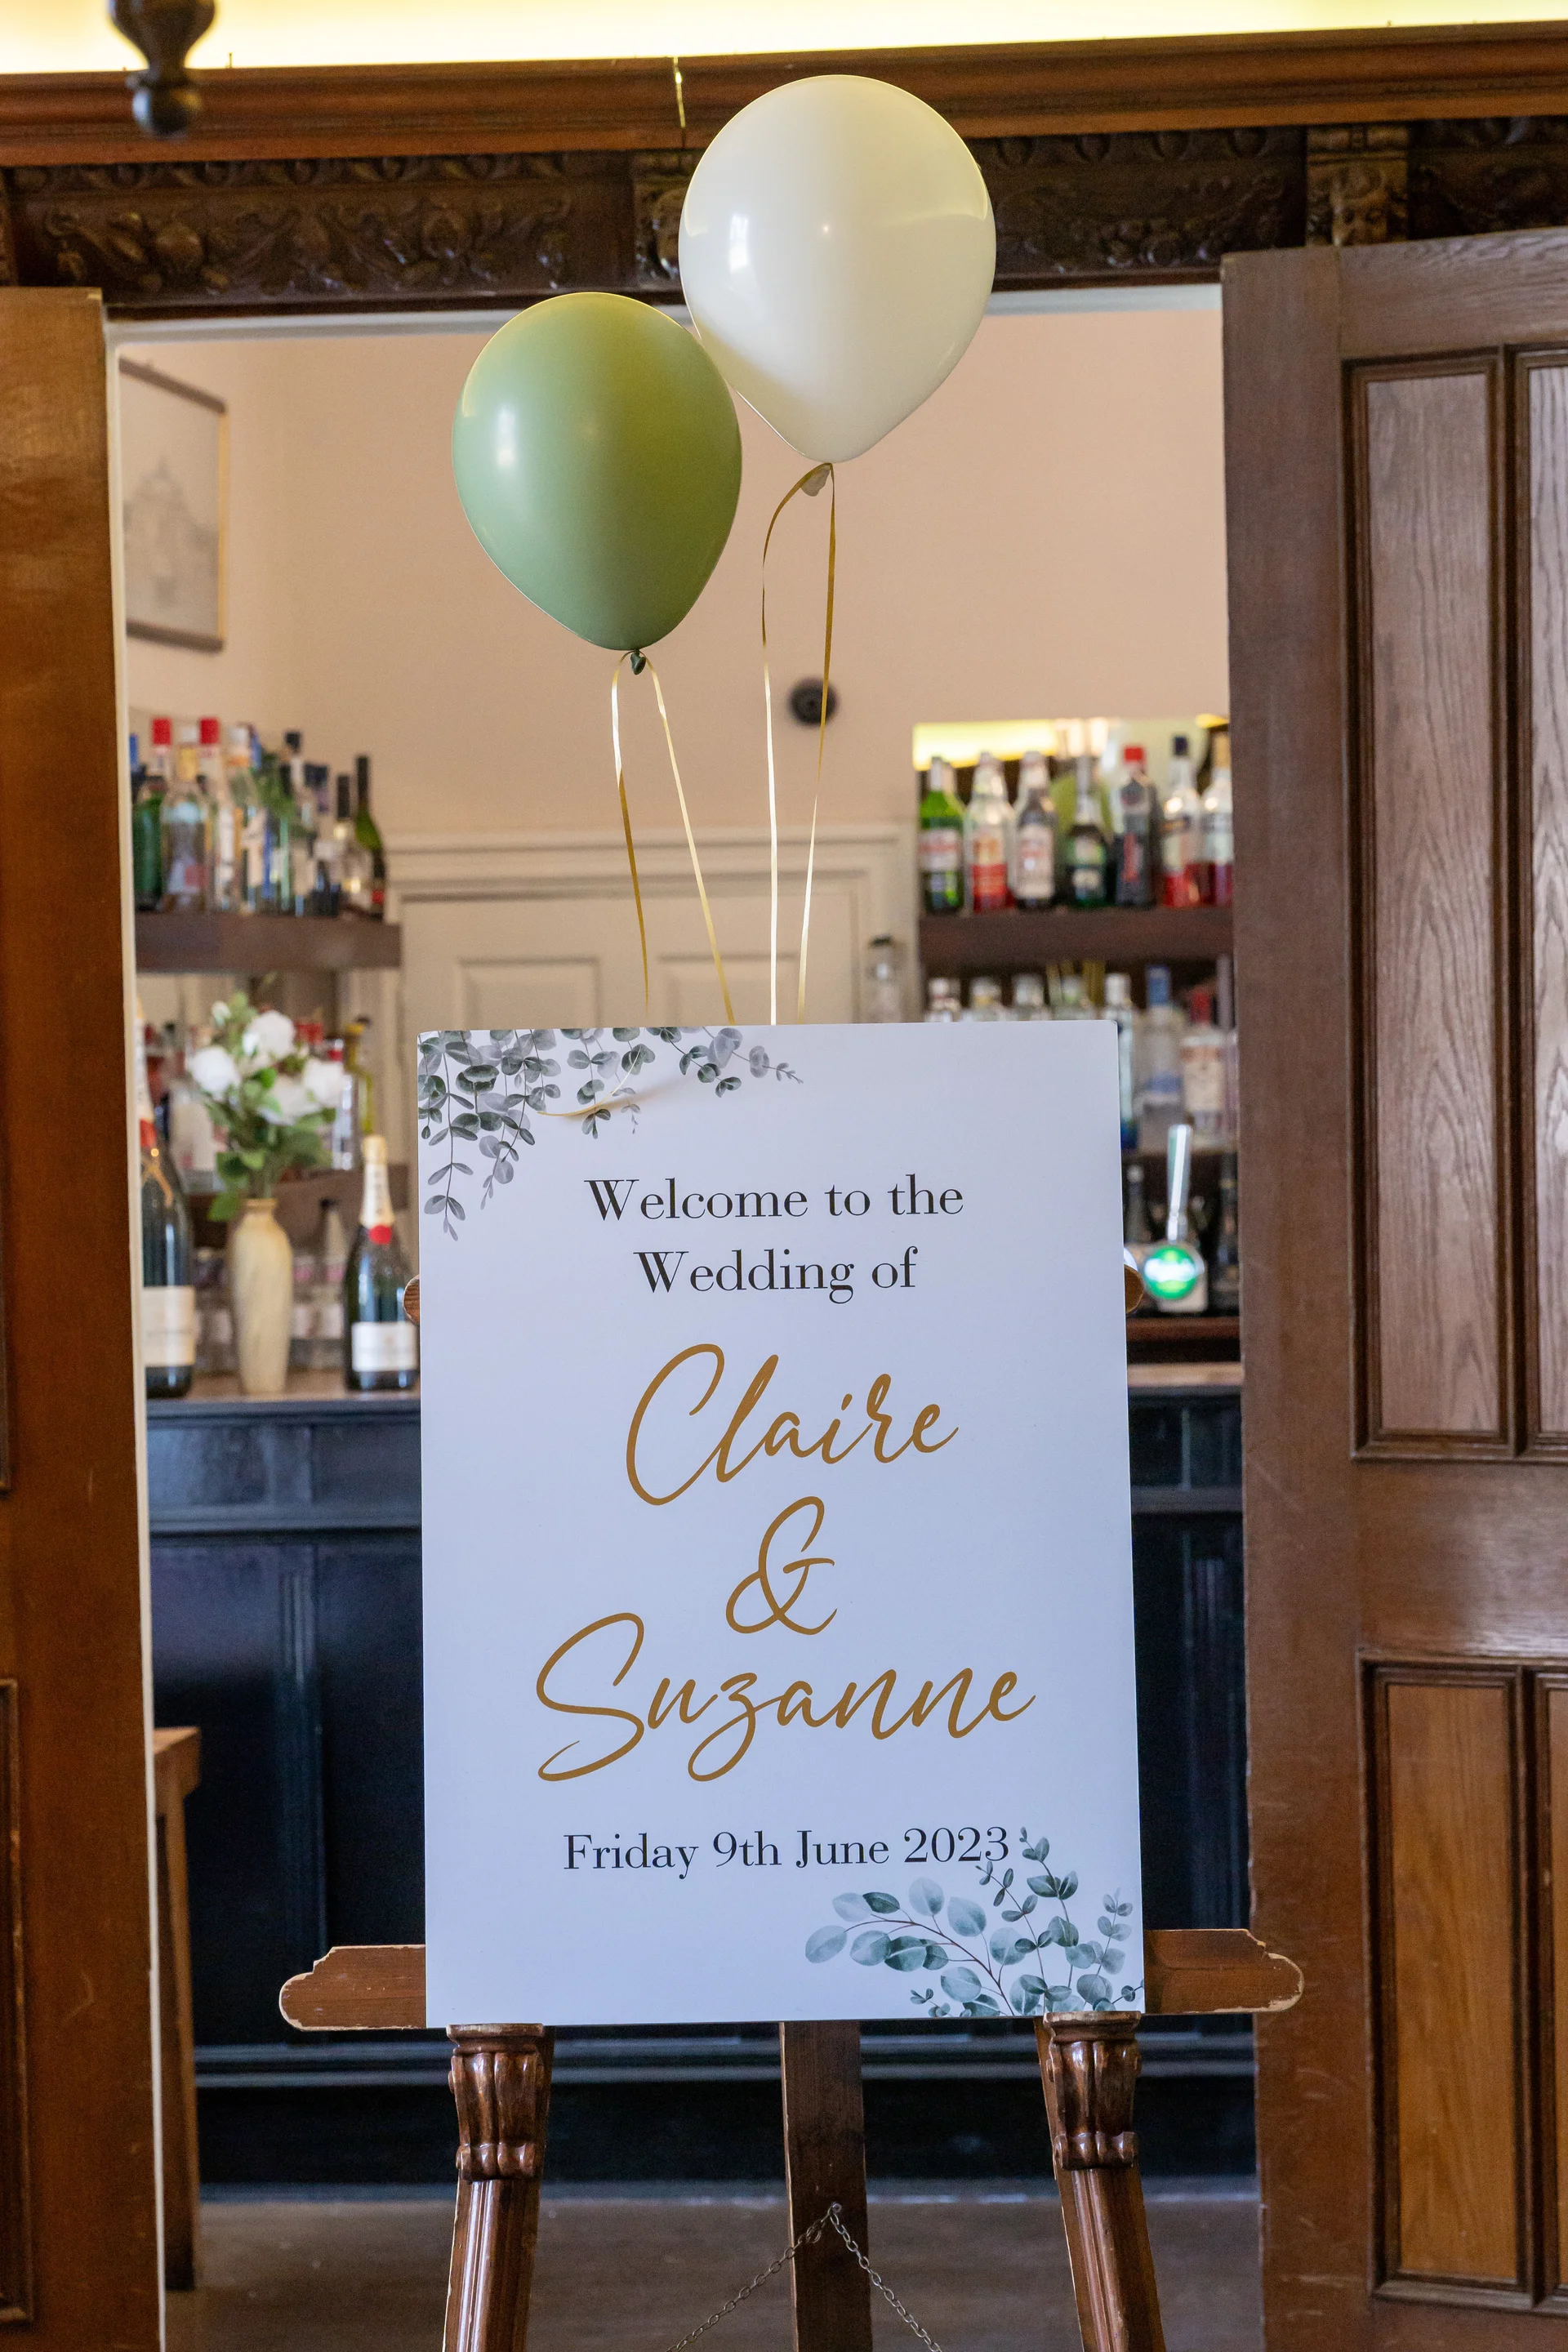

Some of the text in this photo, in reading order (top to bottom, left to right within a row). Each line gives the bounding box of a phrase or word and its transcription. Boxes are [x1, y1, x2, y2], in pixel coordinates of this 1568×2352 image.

[584, 1174, 963, 1221] Welcome to the
[633, 1246, 918, 1304] Wedding of
[626, 1344, 958, 1506] Claire
[726, 1496, 837, 1635] &
[537, 1612, 1036, 1781] Suzanne
[564, 1827, 1009, 1879] Friday 9th June 2023
